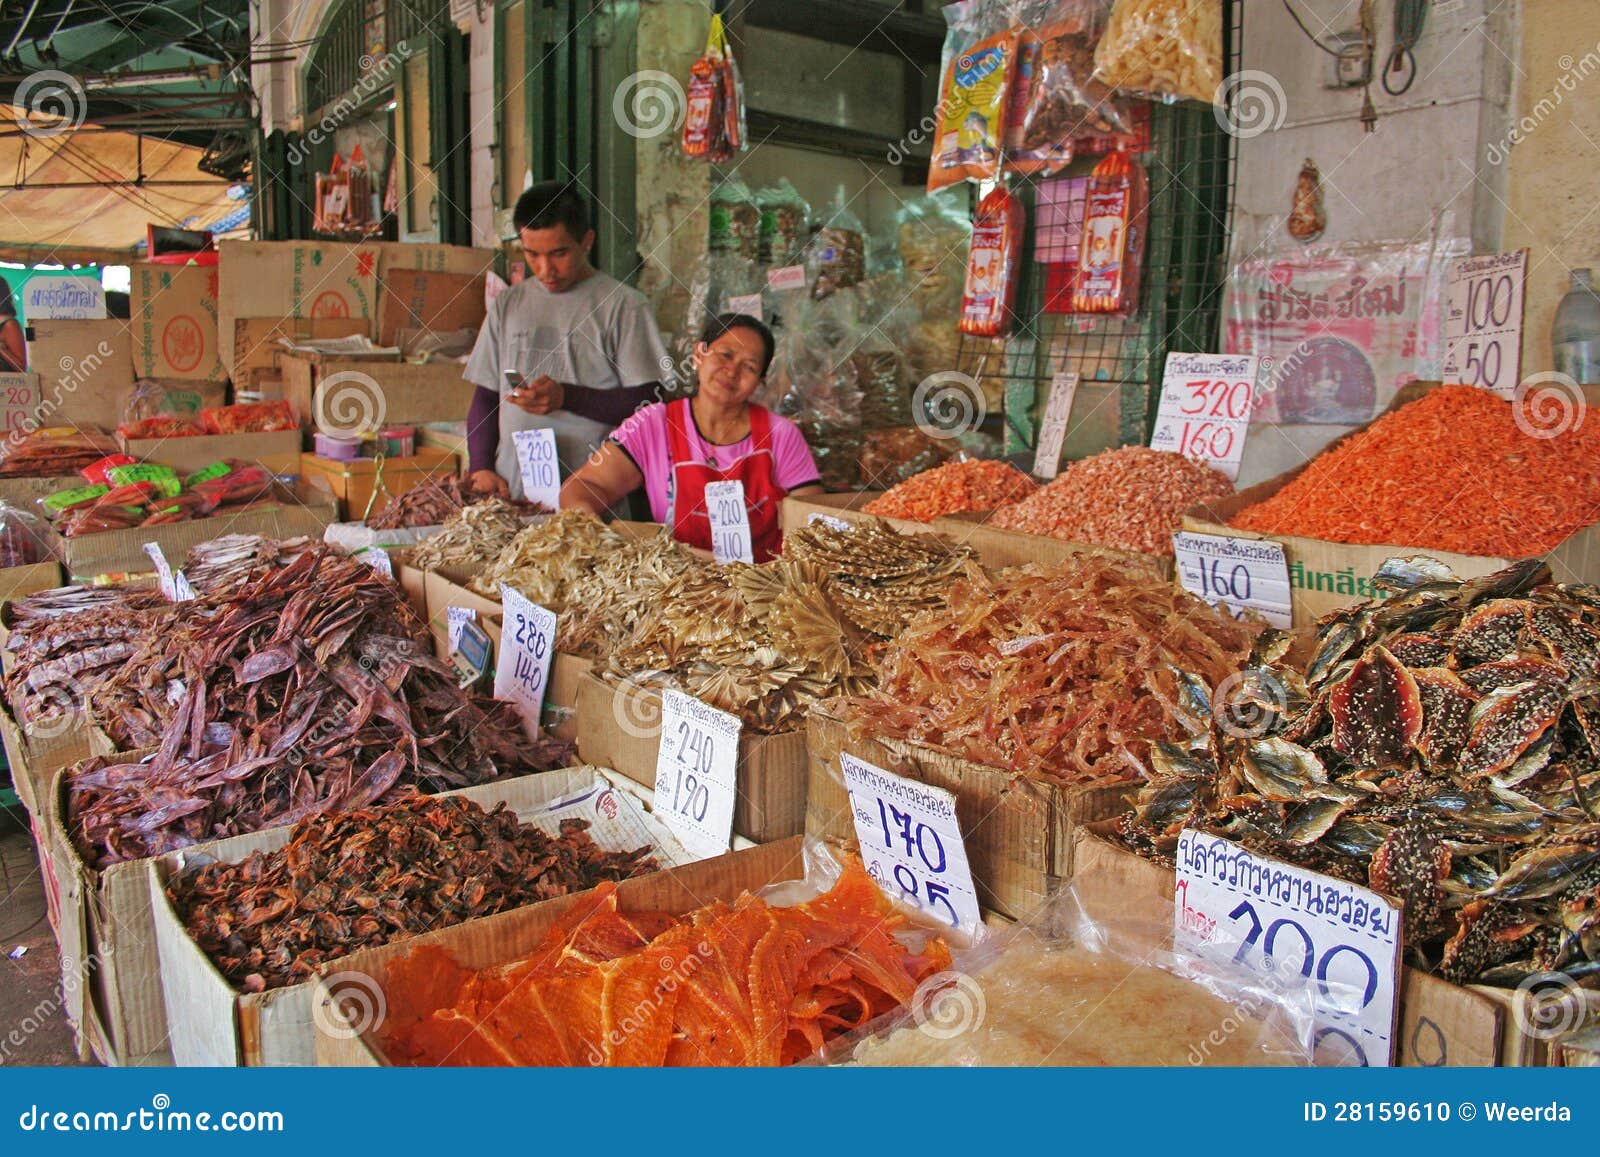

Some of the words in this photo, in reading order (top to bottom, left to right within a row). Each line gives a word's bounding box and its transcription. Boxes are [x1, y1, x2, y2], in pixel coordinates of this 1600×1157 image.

[1464, 274, 1513, 334] 100
[1459, 340, 1502, 388] 50
[7, 387, 32, 406] 20
[1180, 380, 1251, 419] 320
[527, 440, 553, 462] 220
[1179, 421, 1235, 459] 160
[531, 463, 553, 488] 110
[717, 499, 741, 526] 220
[722, 532, 743, 560] 110
[1199, 556, 1251, 600] 160
[515, 613, 547, 660] 280
[514, 651, 542, 693] 140
[676, 720, 714, 774] 240
[877, 797, 947, 873] 170
[1179, 832, 1391, 936] ปลาริวกิวหวานอร่อย
[1228, 899, 1378, 1010] 200
